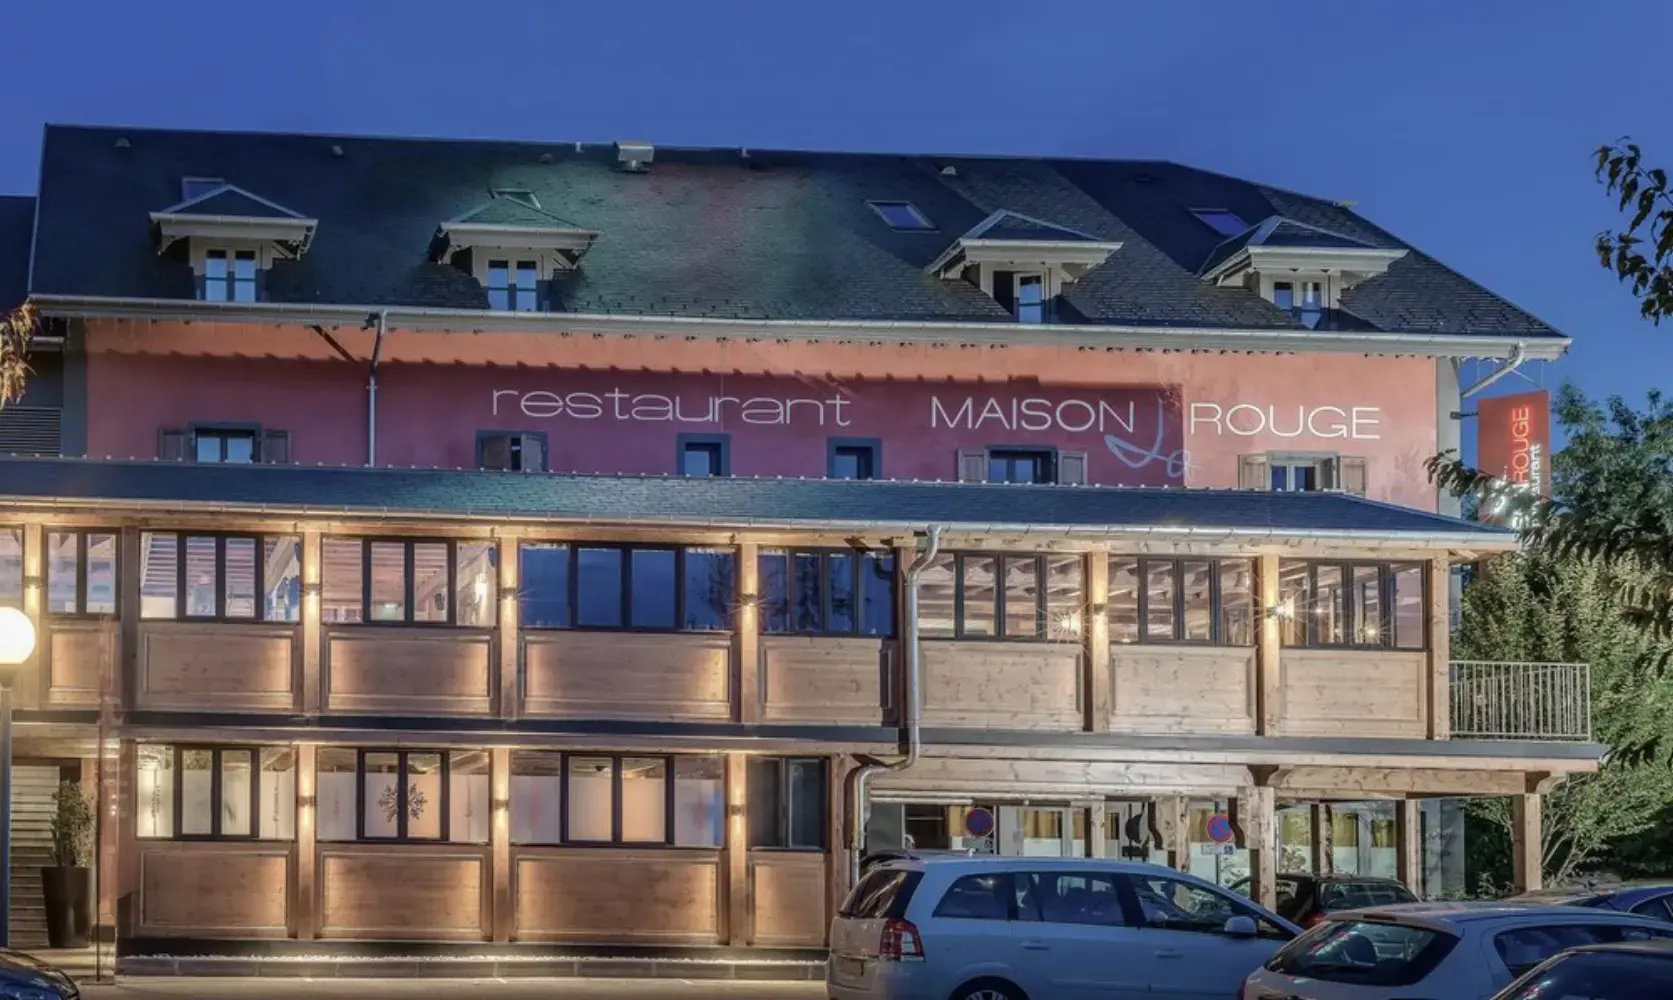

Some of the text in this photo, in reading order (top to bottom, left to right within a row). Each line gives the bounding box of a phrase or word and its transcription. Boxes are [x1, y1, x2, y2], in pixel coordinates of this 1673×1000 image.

[492, 387, 851, 427] restaurant
[931, 396, 1381, 439] MAISON ROUGE
[1512, 407, 1529, 484] ROUGE
